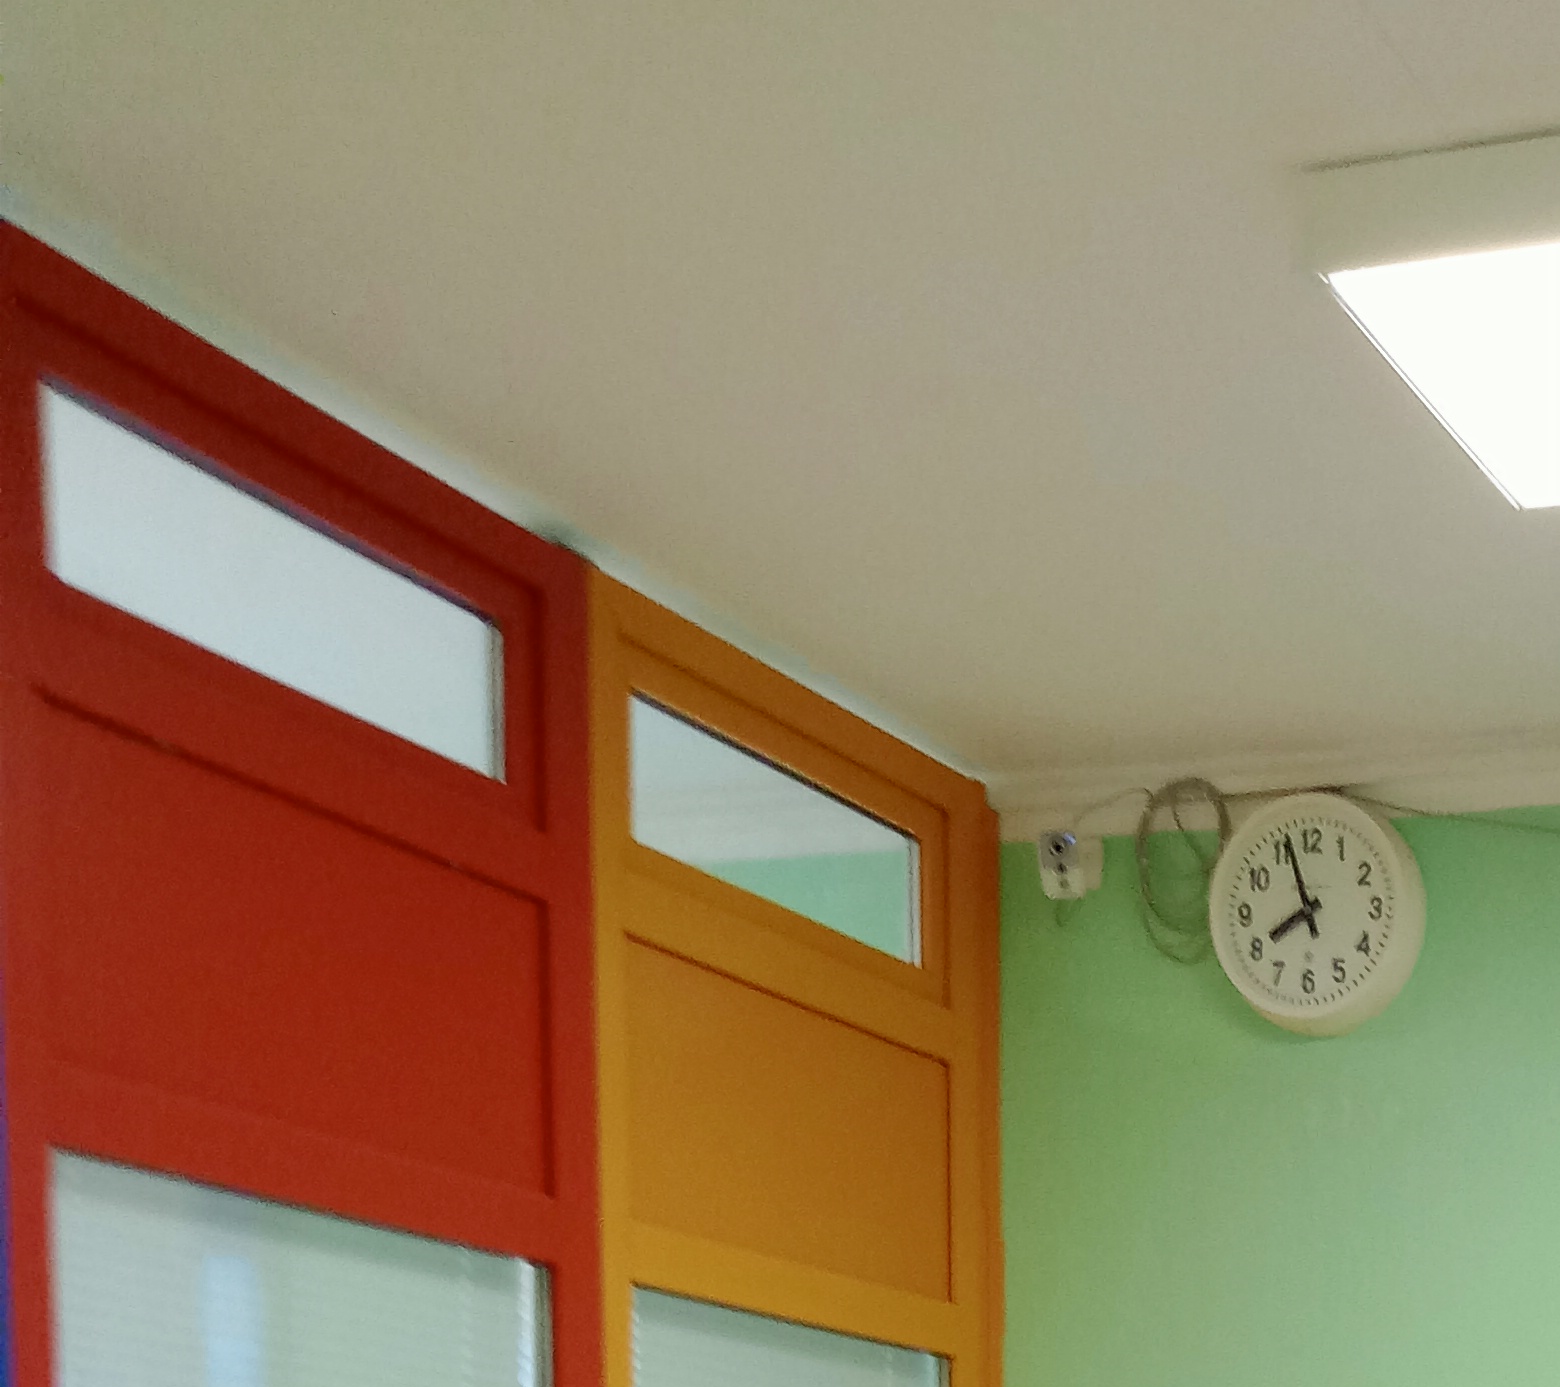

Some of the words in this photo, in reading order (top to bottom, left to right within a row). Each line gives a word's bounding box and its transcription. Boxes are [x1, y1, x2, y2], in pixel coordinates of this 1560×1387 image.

[1302, 827, 1323, 855] 12
[1336, 835, 1345, 862] 1
[1249, 865, 1270, 892] 10
[1357, 860, 1372, 887] 2
[1237, 902, 1252, 928] 9
[1368, 896, 1383, 920] 3
[1250, 936, 1263, 962] 8
[1354, 930, 1371, 957] 4
[1272, 960, 1286, 987] 7
[1302, 968, 1315, 994] 6
[1332, 957, 1346, 983] 5
